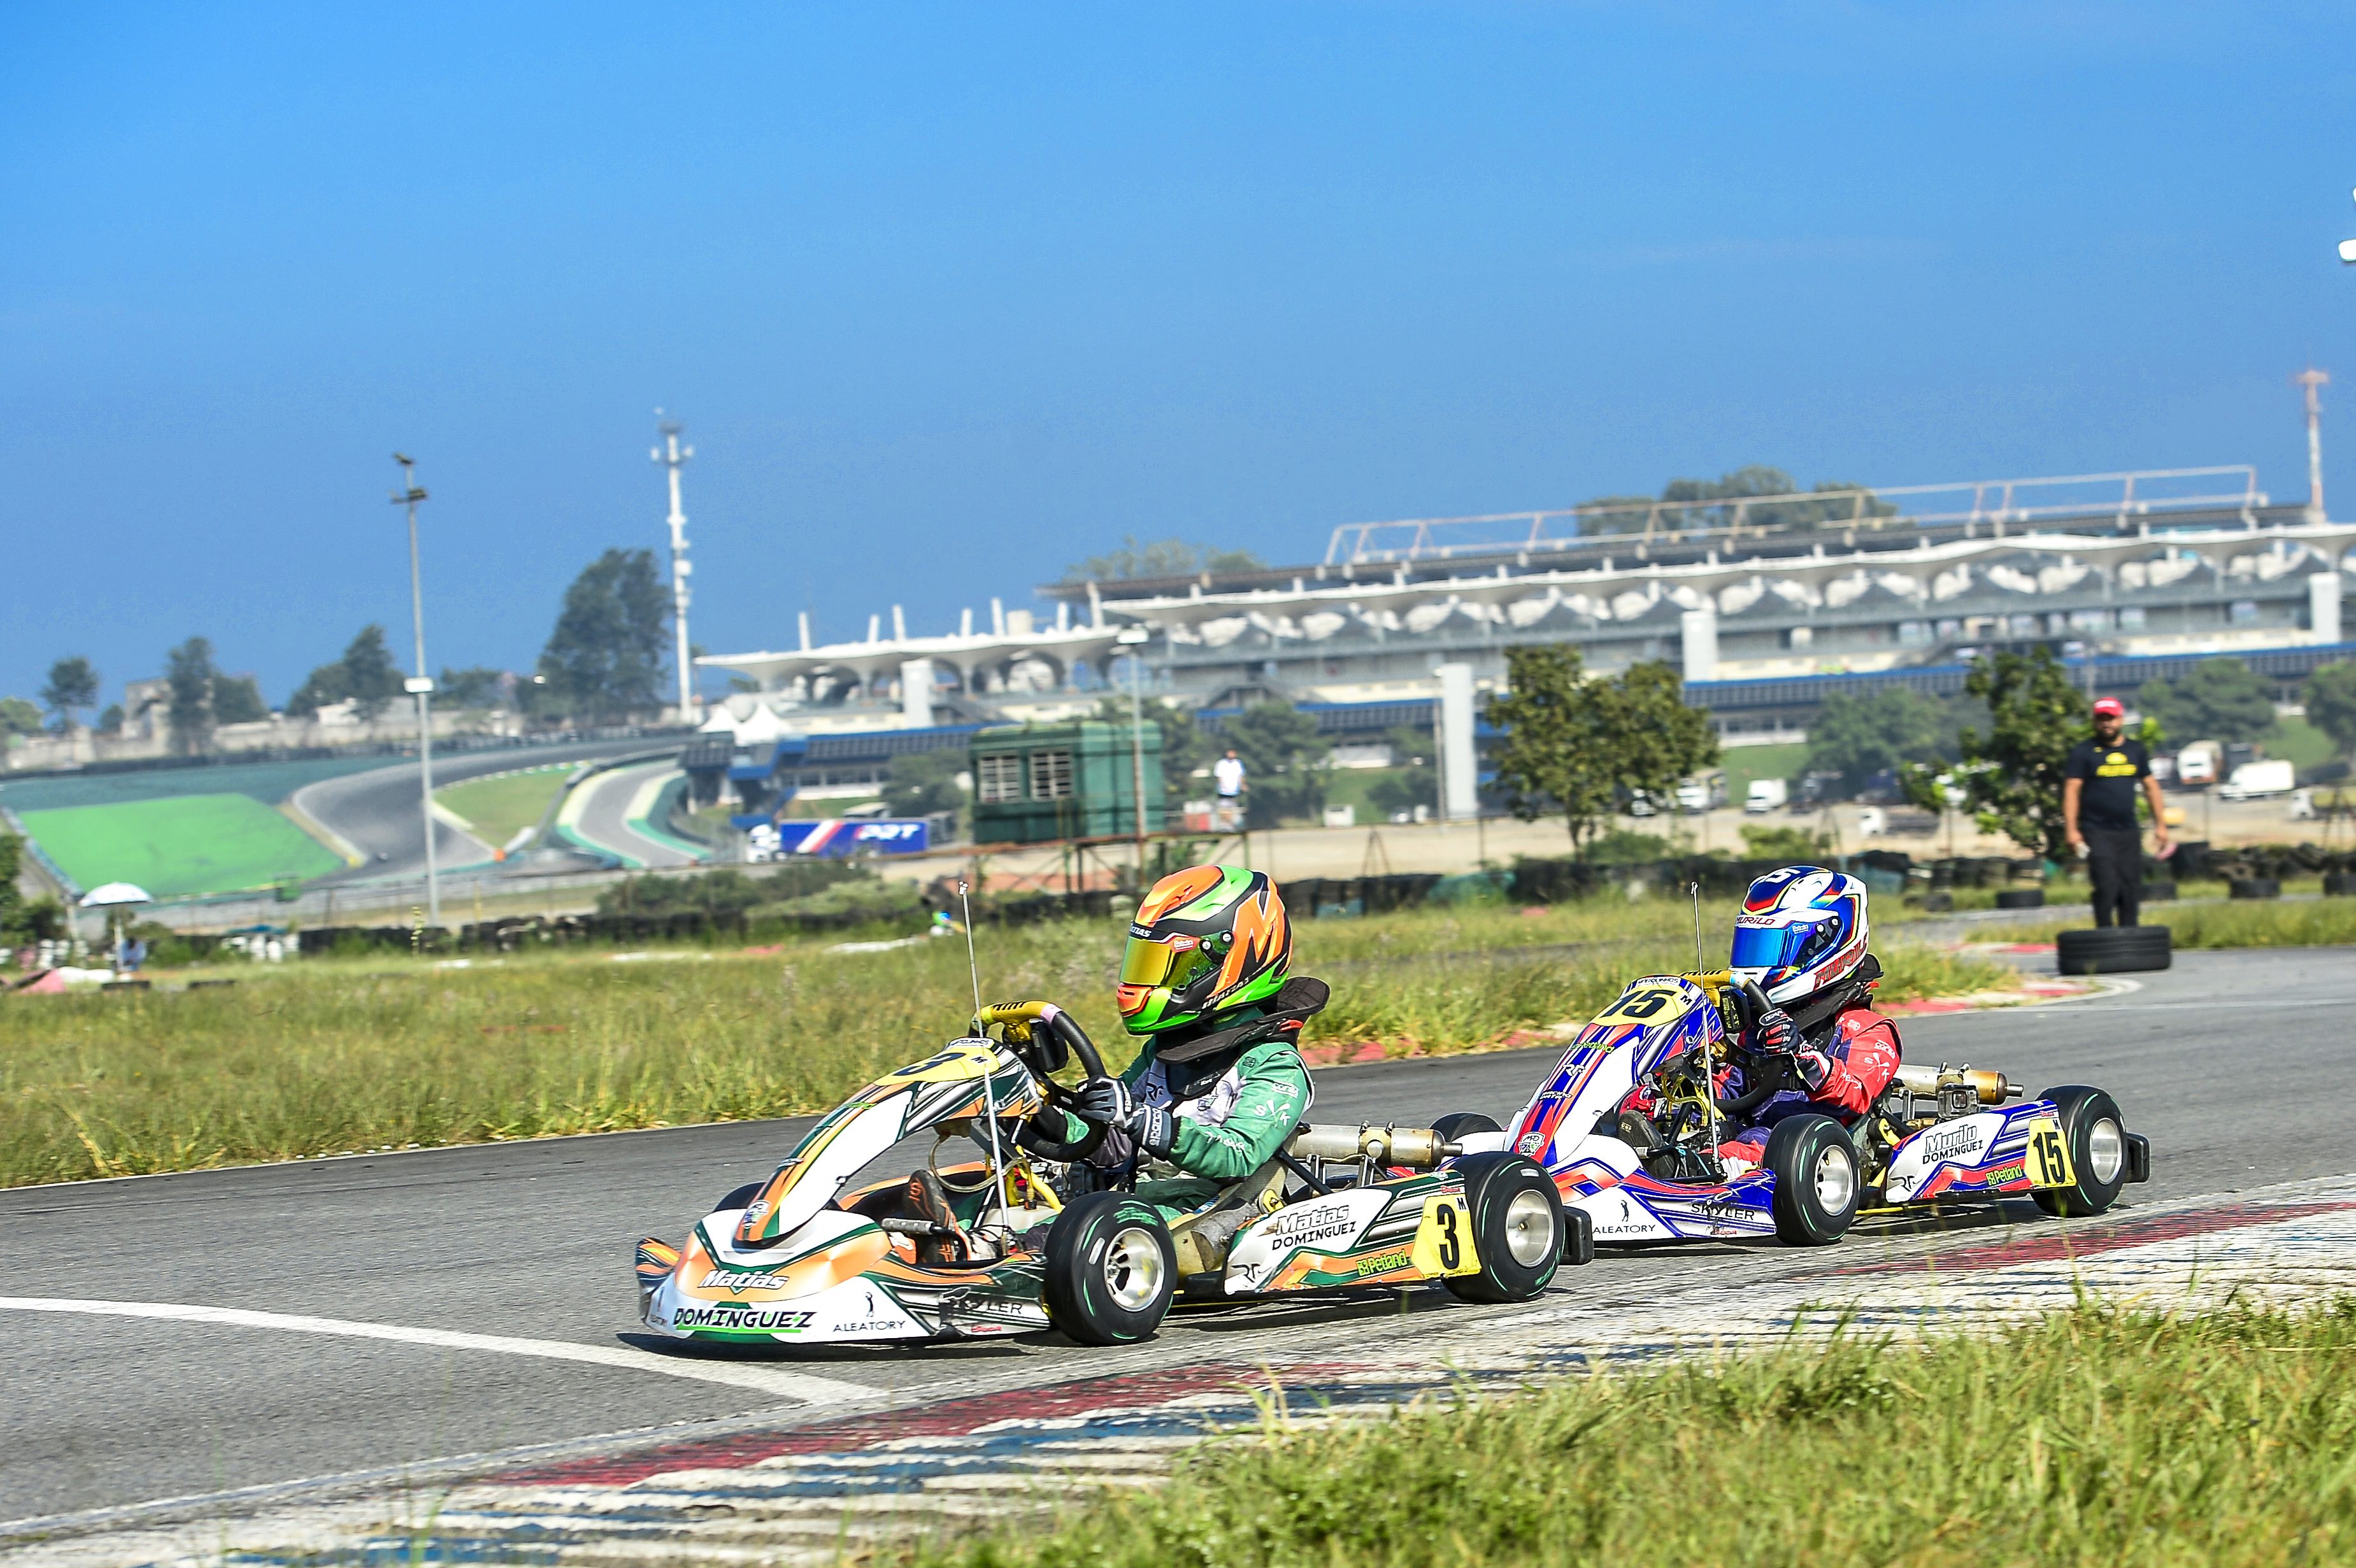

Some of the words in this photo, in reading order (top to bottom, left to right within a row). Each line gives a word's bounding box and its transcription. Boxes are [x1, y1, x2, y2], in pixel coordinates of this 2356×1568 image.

[1599, 989, 1677, 1018] 15
[1680, 995, 1692, 1006] M
[1922, 1139, 1983, 1165] DOMINGUEZ
[1925, 1124, 1977, 1154] Murilo
[2033, 1132, 2066, 1185] 15
[1456, 1197, 1467, 1210] M
[1276, 1204, 1350, 1236] Matias
[1592, 1224, 1656, 1234] ALEATORY
[1272, 1221, 1356, 1251] DOMINGUEZ
[1437, 1204, 1460, 1270] 3
[697, 1269, 790, 1290] Matias
[673, 1308, 818, 1328] DOMINGUEZ
[832, 1320, 906, 1333] ALEATORY
